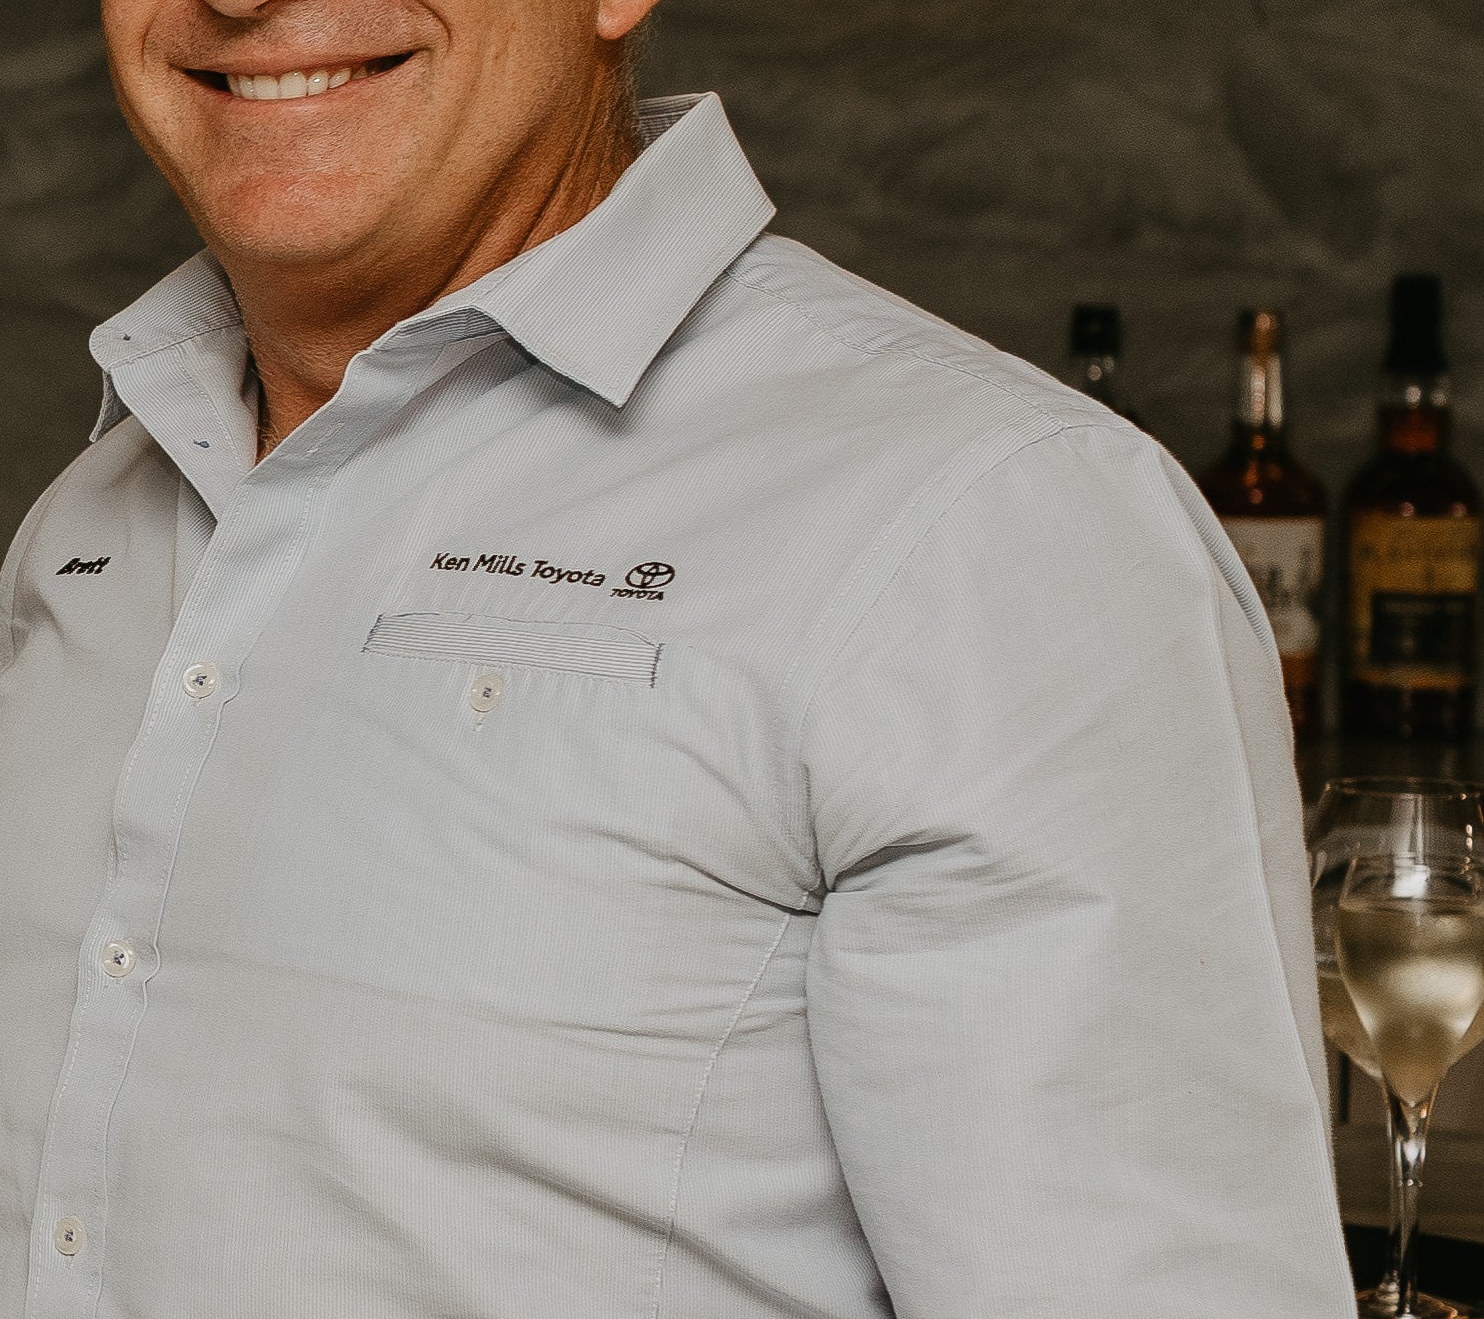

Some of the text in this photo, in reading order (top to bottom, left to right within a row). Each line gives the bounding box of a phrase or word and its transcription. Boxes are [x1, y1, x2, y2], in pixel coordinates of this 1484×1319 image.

[430, 552, 607, 587] Ken Mills Toyota
[610, 588, 665, 601] TOYOTA
